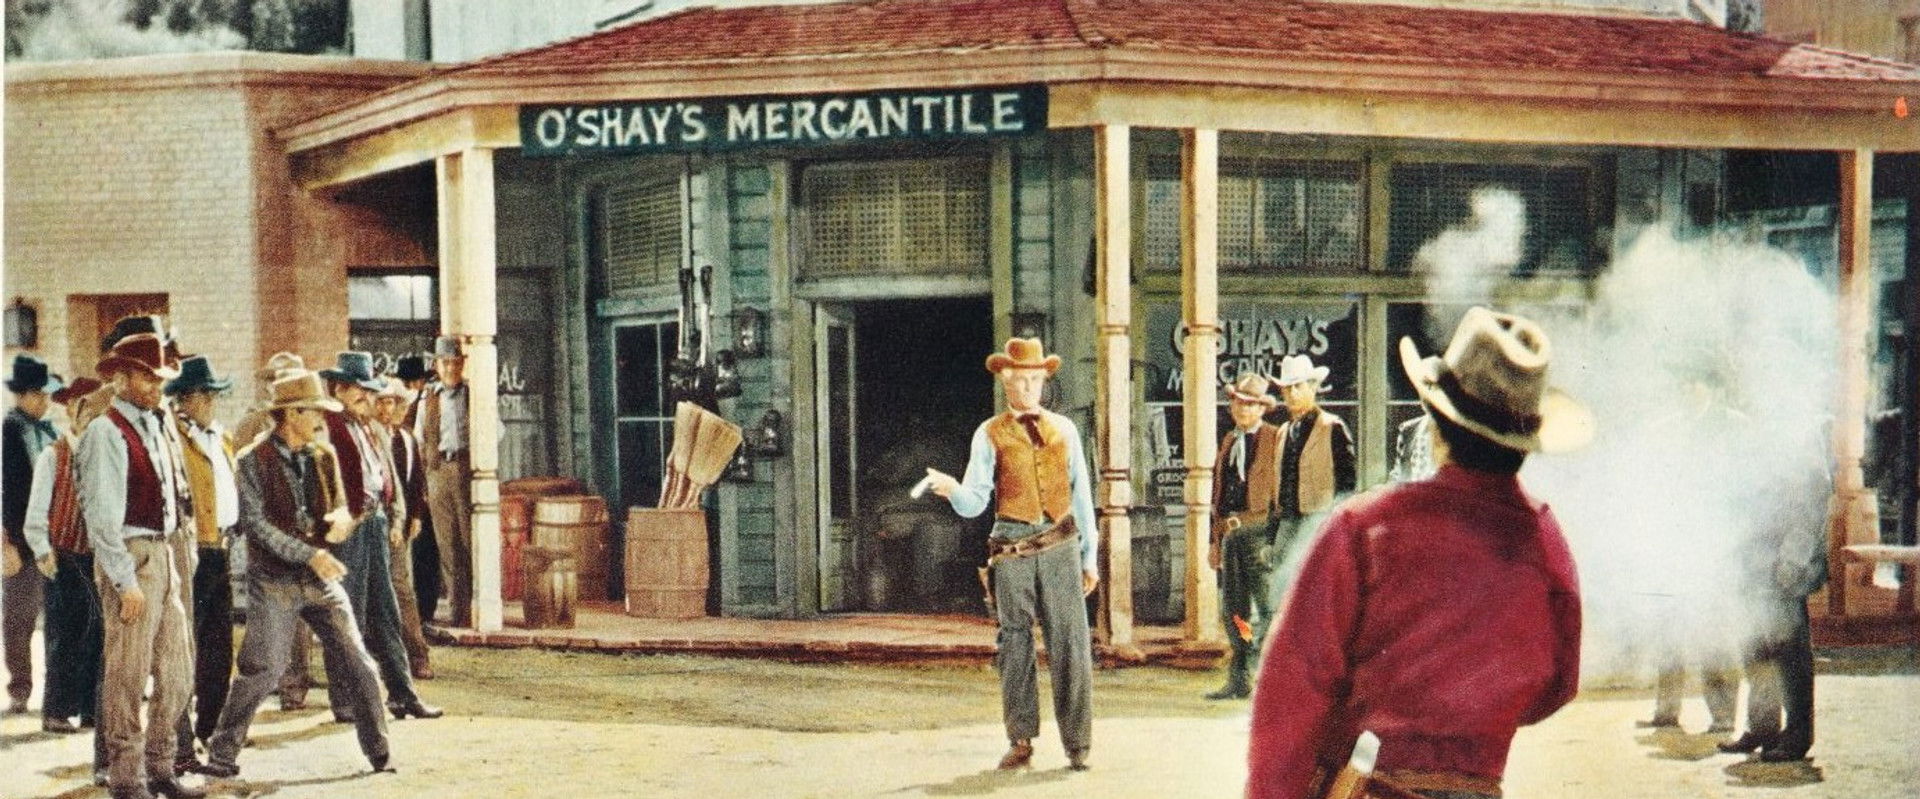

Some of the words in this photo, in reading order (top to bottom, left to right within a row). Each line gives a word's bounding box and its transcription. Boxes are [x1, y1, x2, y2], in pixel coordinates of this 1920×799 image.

[535, 103, 706, 148] O'SHAY'S
[727, 92, 1024, 142] MERCANTILE
[1173, 315, 1330, 355] SHAY'S
